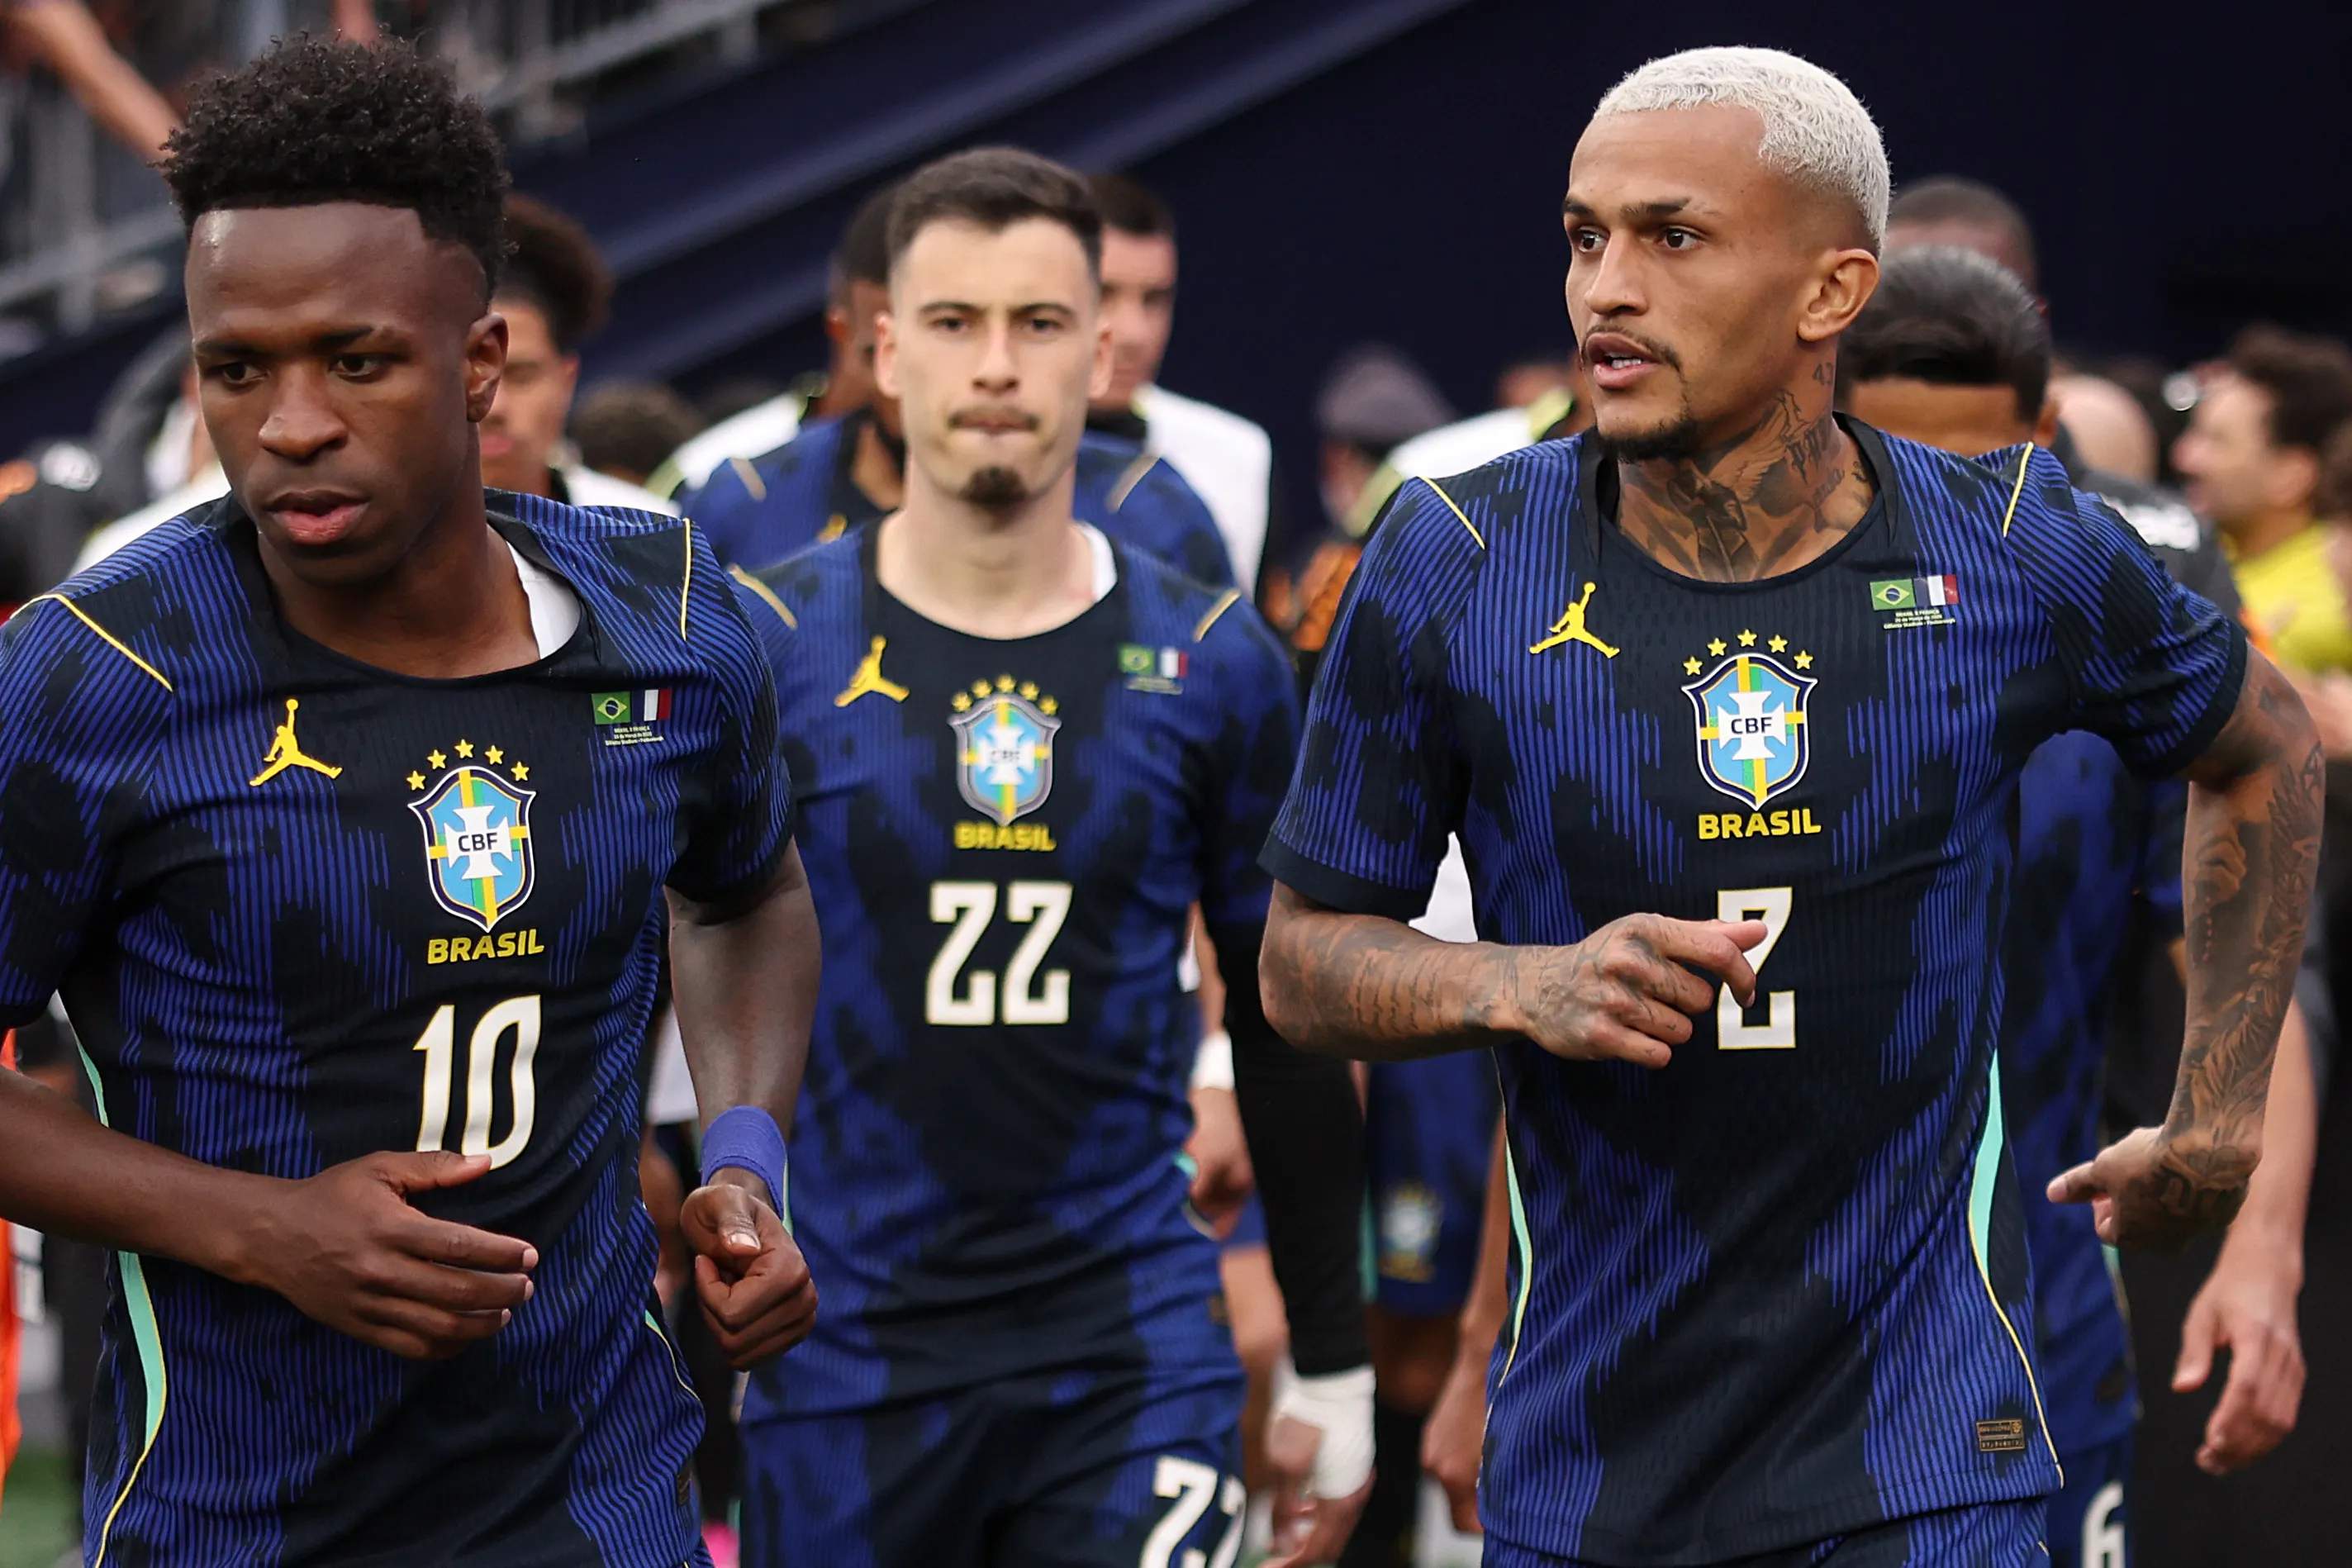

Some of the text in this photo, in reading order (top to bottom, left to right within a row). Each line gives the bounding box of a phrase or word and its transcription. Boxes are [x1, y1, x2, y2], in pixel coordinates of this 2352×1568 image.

[1731, 717, 1773, 734] CBF
[954, 822, 1057, 852] BRASIL
[1699, 809, 1822, 840] BRASIL
[458, 832, 498, 853] CBF
[427, 929, 544, 964] BRASIL
[926, 881, 1073, 1025] 22
[1717, 886, 1796, 1050] 2
[413, 995, 541, 1171] 10
